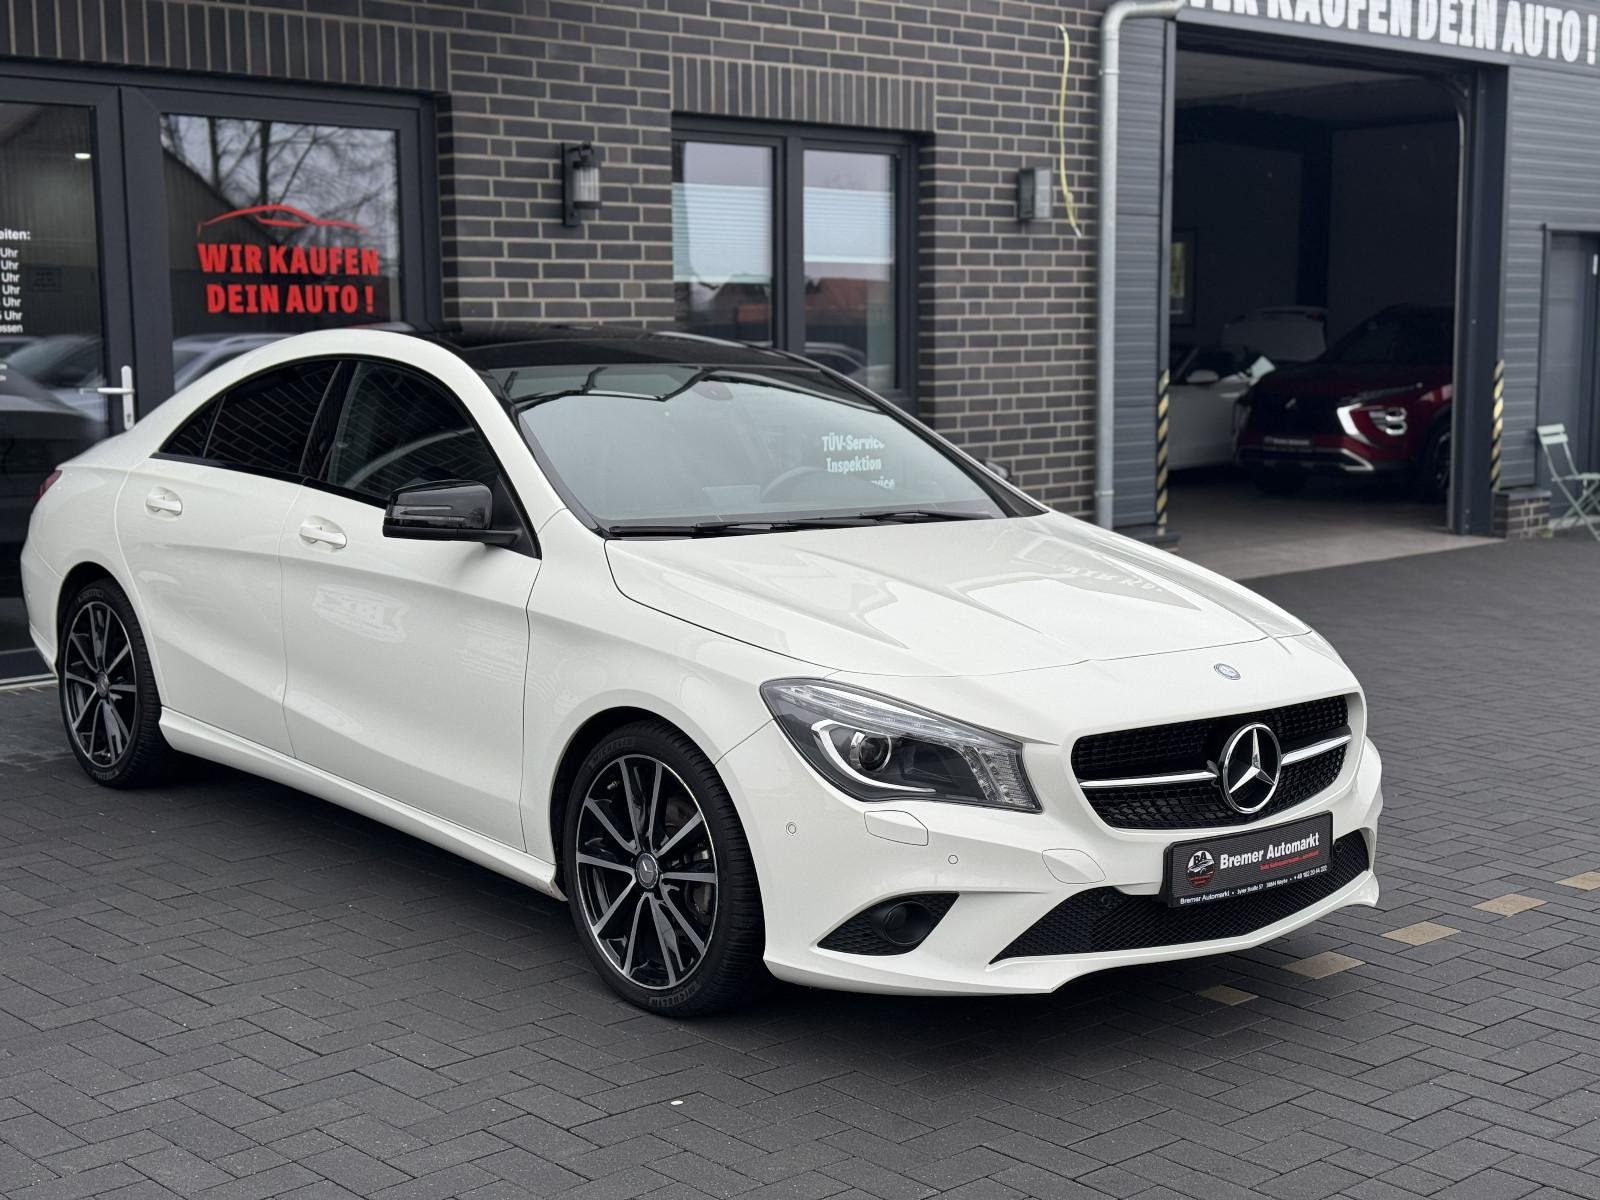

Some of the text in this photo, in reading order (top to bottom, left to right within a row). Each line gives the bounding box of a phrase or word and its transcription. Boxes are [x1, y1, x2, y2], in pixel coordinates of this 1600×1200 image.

[1417, 0, 1498, 50] DEIN
[1502, 0, 1581, 63] AUTO
[1586, 14, 1598, 65] !
[0, 248, 18, 258] Uhr
[197, 243, 379, 276] WIR KAUFEN
[1, 260, 19, 270] Uhr
[1, 272, 20, 283] Uhr
[2, 285, 21, 295] Uhr
[3, 297, 21, 307] Uhr
[206, 284, 374, 313] DEIN AUTO !
[4, 310, 23, 321] Uhr
[826, 455, 882, 474] Inspektion
[1220, 851, 1264, 870] Bremer
[1266, 832, 1320, 860] Automarkt
[1180, 896, 1202, 905] Bremer
[1202, 890, 1230, 901] Automarkt
